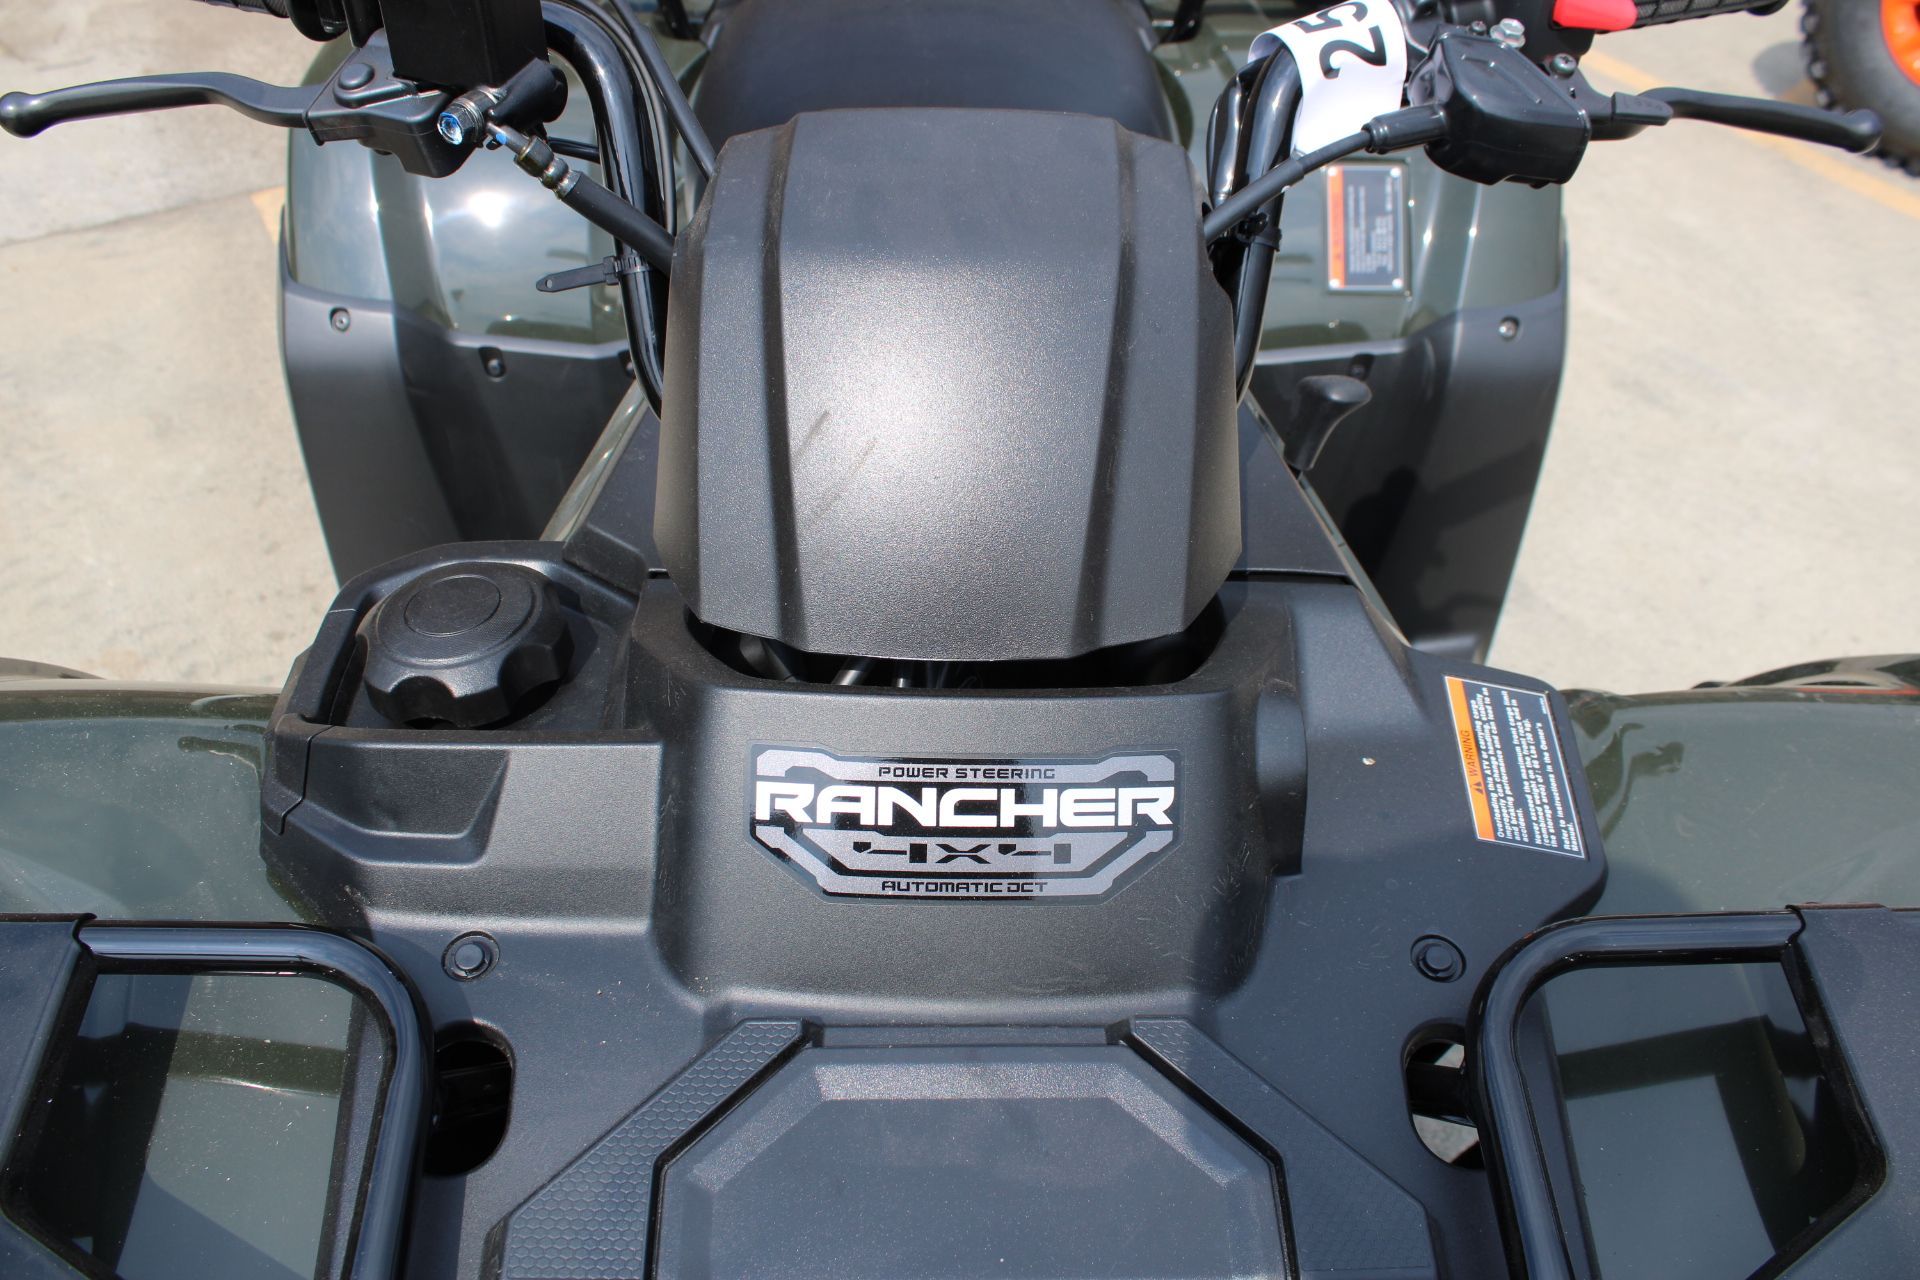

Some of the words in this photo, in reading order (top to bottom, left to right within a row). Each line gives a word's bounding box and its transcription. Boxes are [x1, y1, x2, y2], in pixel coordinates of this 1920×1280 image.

[1475, 692, 1488, 721] stability
[1500, 690, 1510, 705] limit
[1469, 699, 1480, 719] cargo
[1485, 704, 1494, 720] lead
[1505, 706, 1516, 726] cargo
[1511, 706, 1521, 720] and
[1473, 719, 1487, 749] carrying
[1489, 720, 1497, 734] can
[1509, 726, 1520, 744] front
[1515, 720, 1525, 736] rack
[1534, 721, 1548, 750] Owner's
[1492, 734, 1501, 748] and
[1519, 737, 1529, 755] front
[1459, 728, 1478, 777] WARNING
[1514, 745, 1528, 779] maximum
[1523, 755, 1532, 768] the
[1541, 751, 1551, 763] the
[878, 766, 949, 779] POWER
[955, 767, 1055, 780] STEERING
[1481, 759, 1491, 775] ATV
[1488, 755, 1502, 782] change
[1495, 749, 1512, 794] performance
[1485, 775, 1495, 791] this
[1495, 783, 1504, 797] can
[1521, 779, 1531, 792] the
[1529, 779, 1542, 805] weight
[1537, 783, 1549, 803] area)
[755, 781, 1175, 827] RANCHER
[1546, 772, 1564, 818] instructions
[1488, 791, 1506, 838] Overloading
[1505, 795, 1519, 825] braking
[1524, 793, 1537, 820] exceed
[1515, 806, 1529, 842] accident.
[1535, 806, 1551, 846] (combined
[1542, 804, 1556, 833] storage
[1512, 825, 1521, 840] and
[1531, 822, 1542, 844] Never
[1549, 834, 1558, 847] the
[1559, 828, 1571, 850] Refer
[1566, 821, 1579, 851] Manual.
[881, 880, 1003, 893] AUTOMATIC
[1007, 881, 1048, 893] DCT
